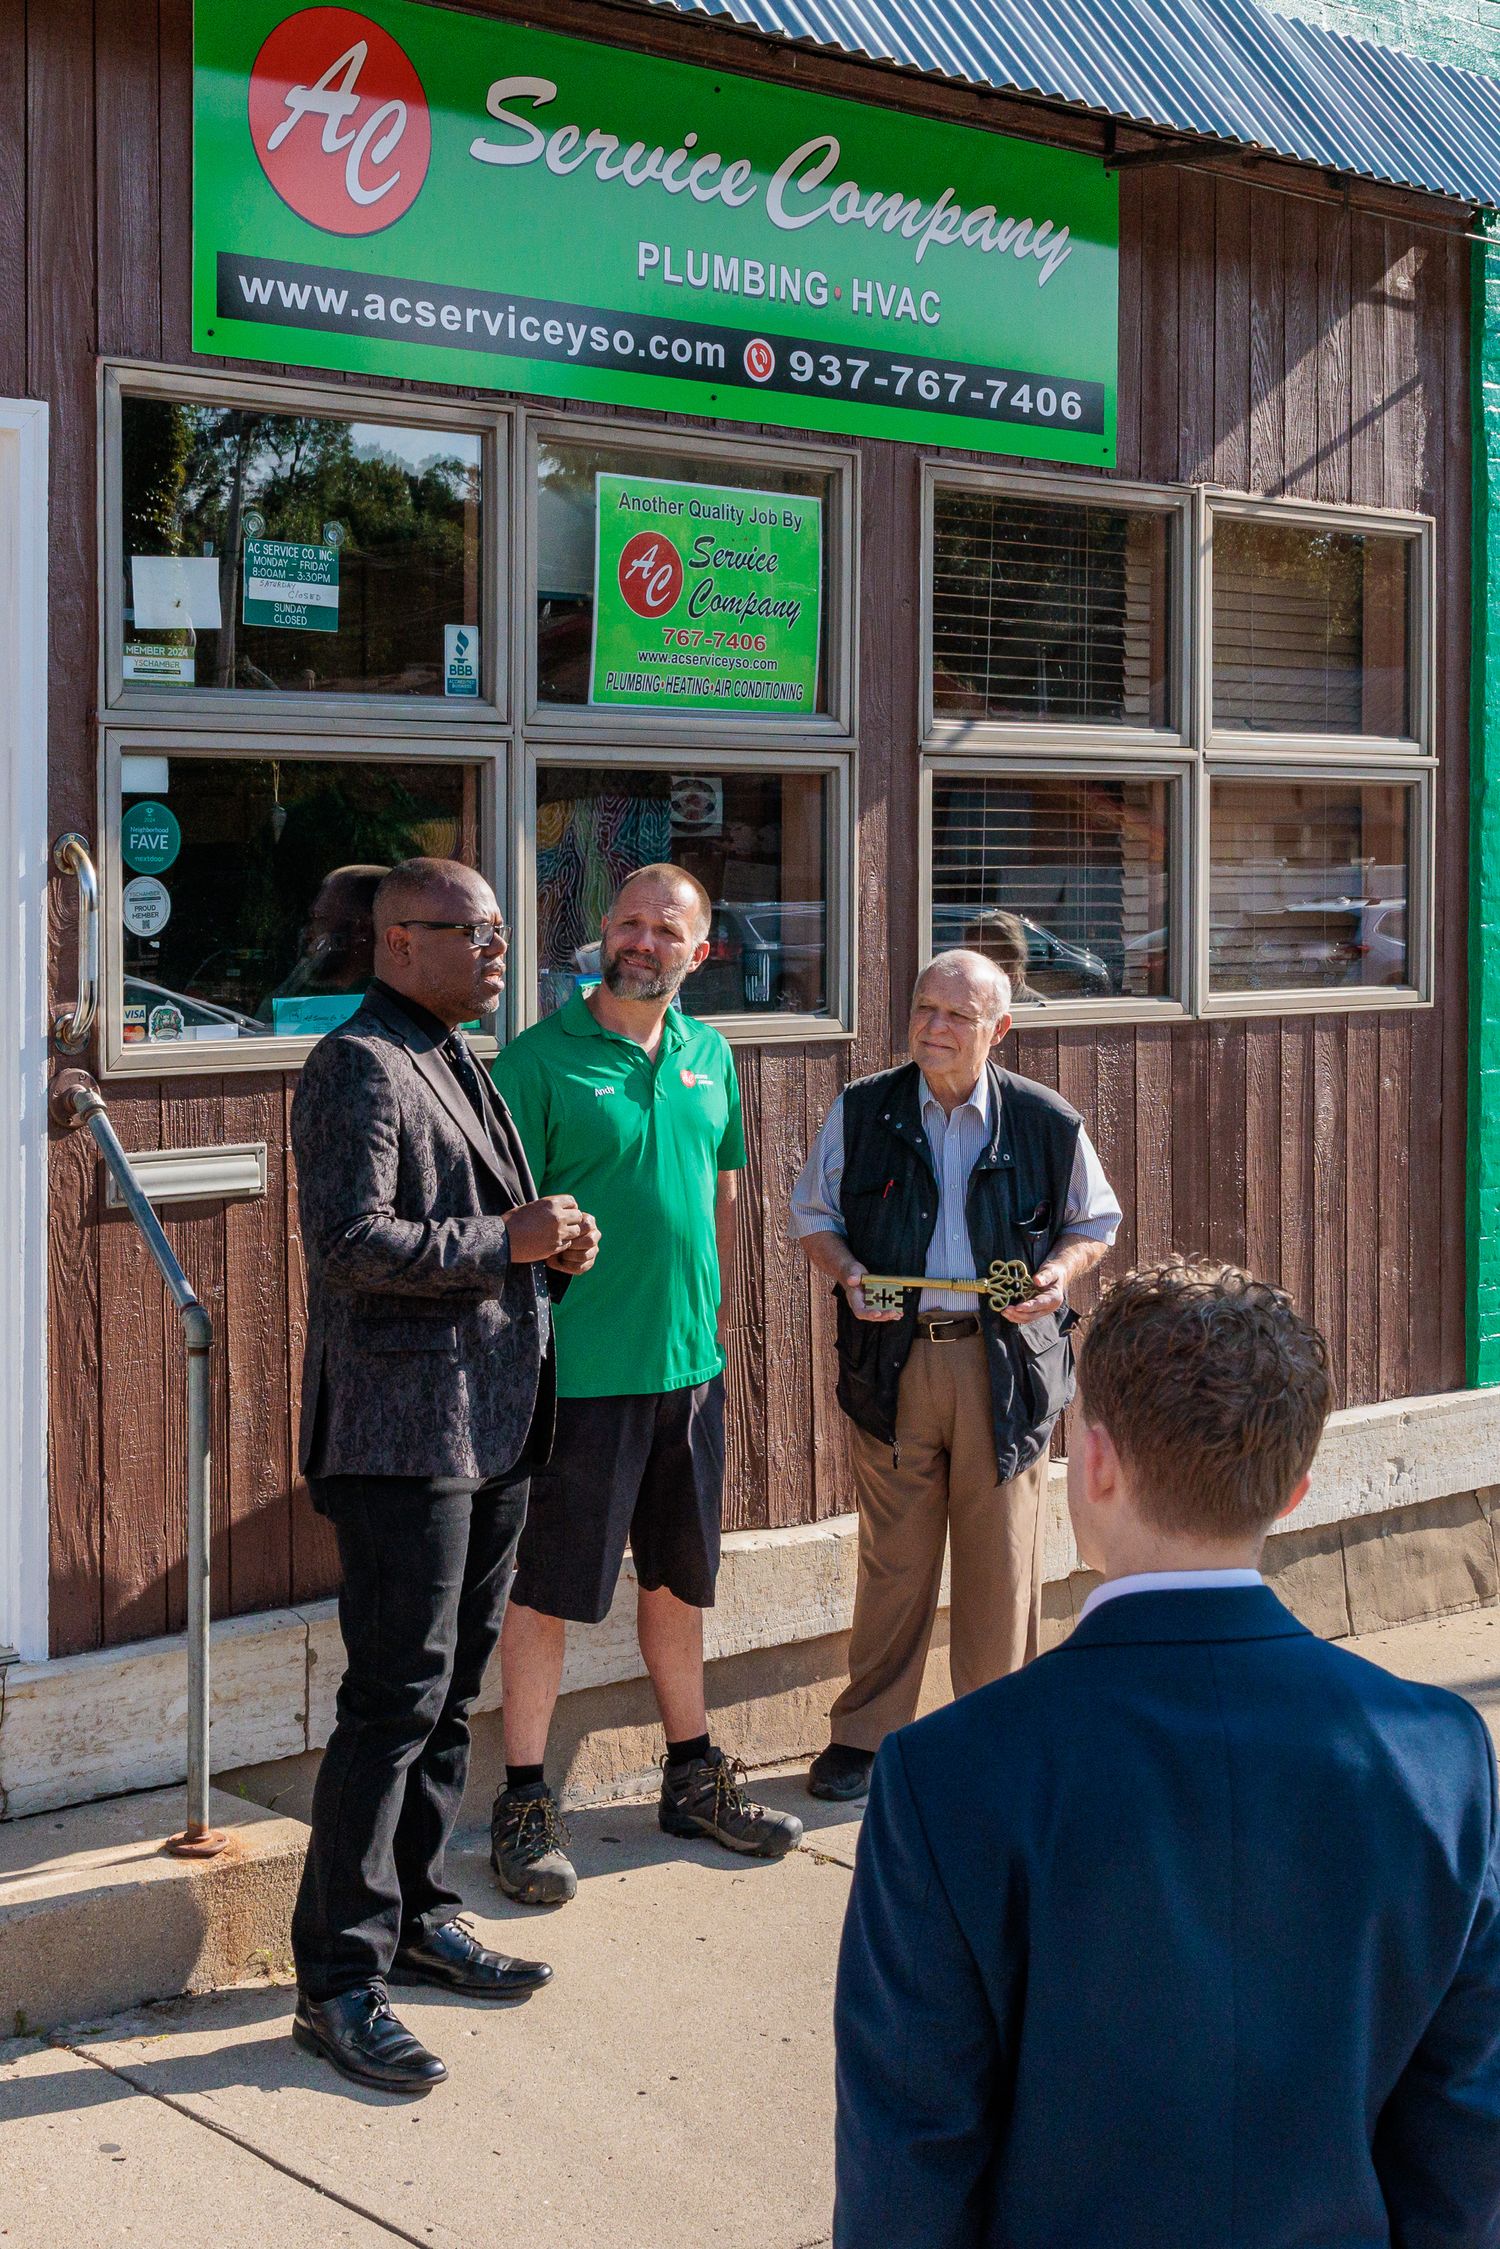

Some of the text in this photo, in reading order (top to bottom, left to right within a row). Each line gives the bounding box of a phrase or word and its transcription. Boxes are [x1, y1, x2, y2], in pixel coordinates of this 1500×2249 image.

[266, 39, 407, 205] AC
[469, 75, 1073, 288] Service Company
[638, 241, 942, 326] PLUMBING HVAC
[238, 274, 1083, 420] www.acserviceyso.com 937-767-7406
[618, 492, 802, 532] Another Quality Job By
[248, 542, 335, 562] AC SERVICE CO. INC.
[688, 536, 778, 573] Service
[253, 556, 288, 567] MONDAY
[300, 560, 329, 572] FRIDAY
[252, 567, 286, 579] 8:00AM
[297, 572, 331, 583] 3:30PM
[625, 544, 673, 607] AC
[260, 580, 297, 590] SATURDAY
[274, 602, 307, 614] SUNDAY
[688, 578, 802, 629] Company
[273, 613, 307, 625] CLOSED
[662, 628, 767, 651] 767-7406
[125, 645, 188, 657] MEMBER 2024
[638, 651, 778, 670] www.acserviceyso.com
[449, 664, 472, 676] BBB
[734, 681, 803, 700] CONDITIONING
[130, 834, 169, 849] FAVE
[132, 911, 160, 919] MEMBER
[134, 904, 157, 912] PROUD
[124, 1009, 145, 1019] VISA
[594, 1085, 615, 1097] Andy
